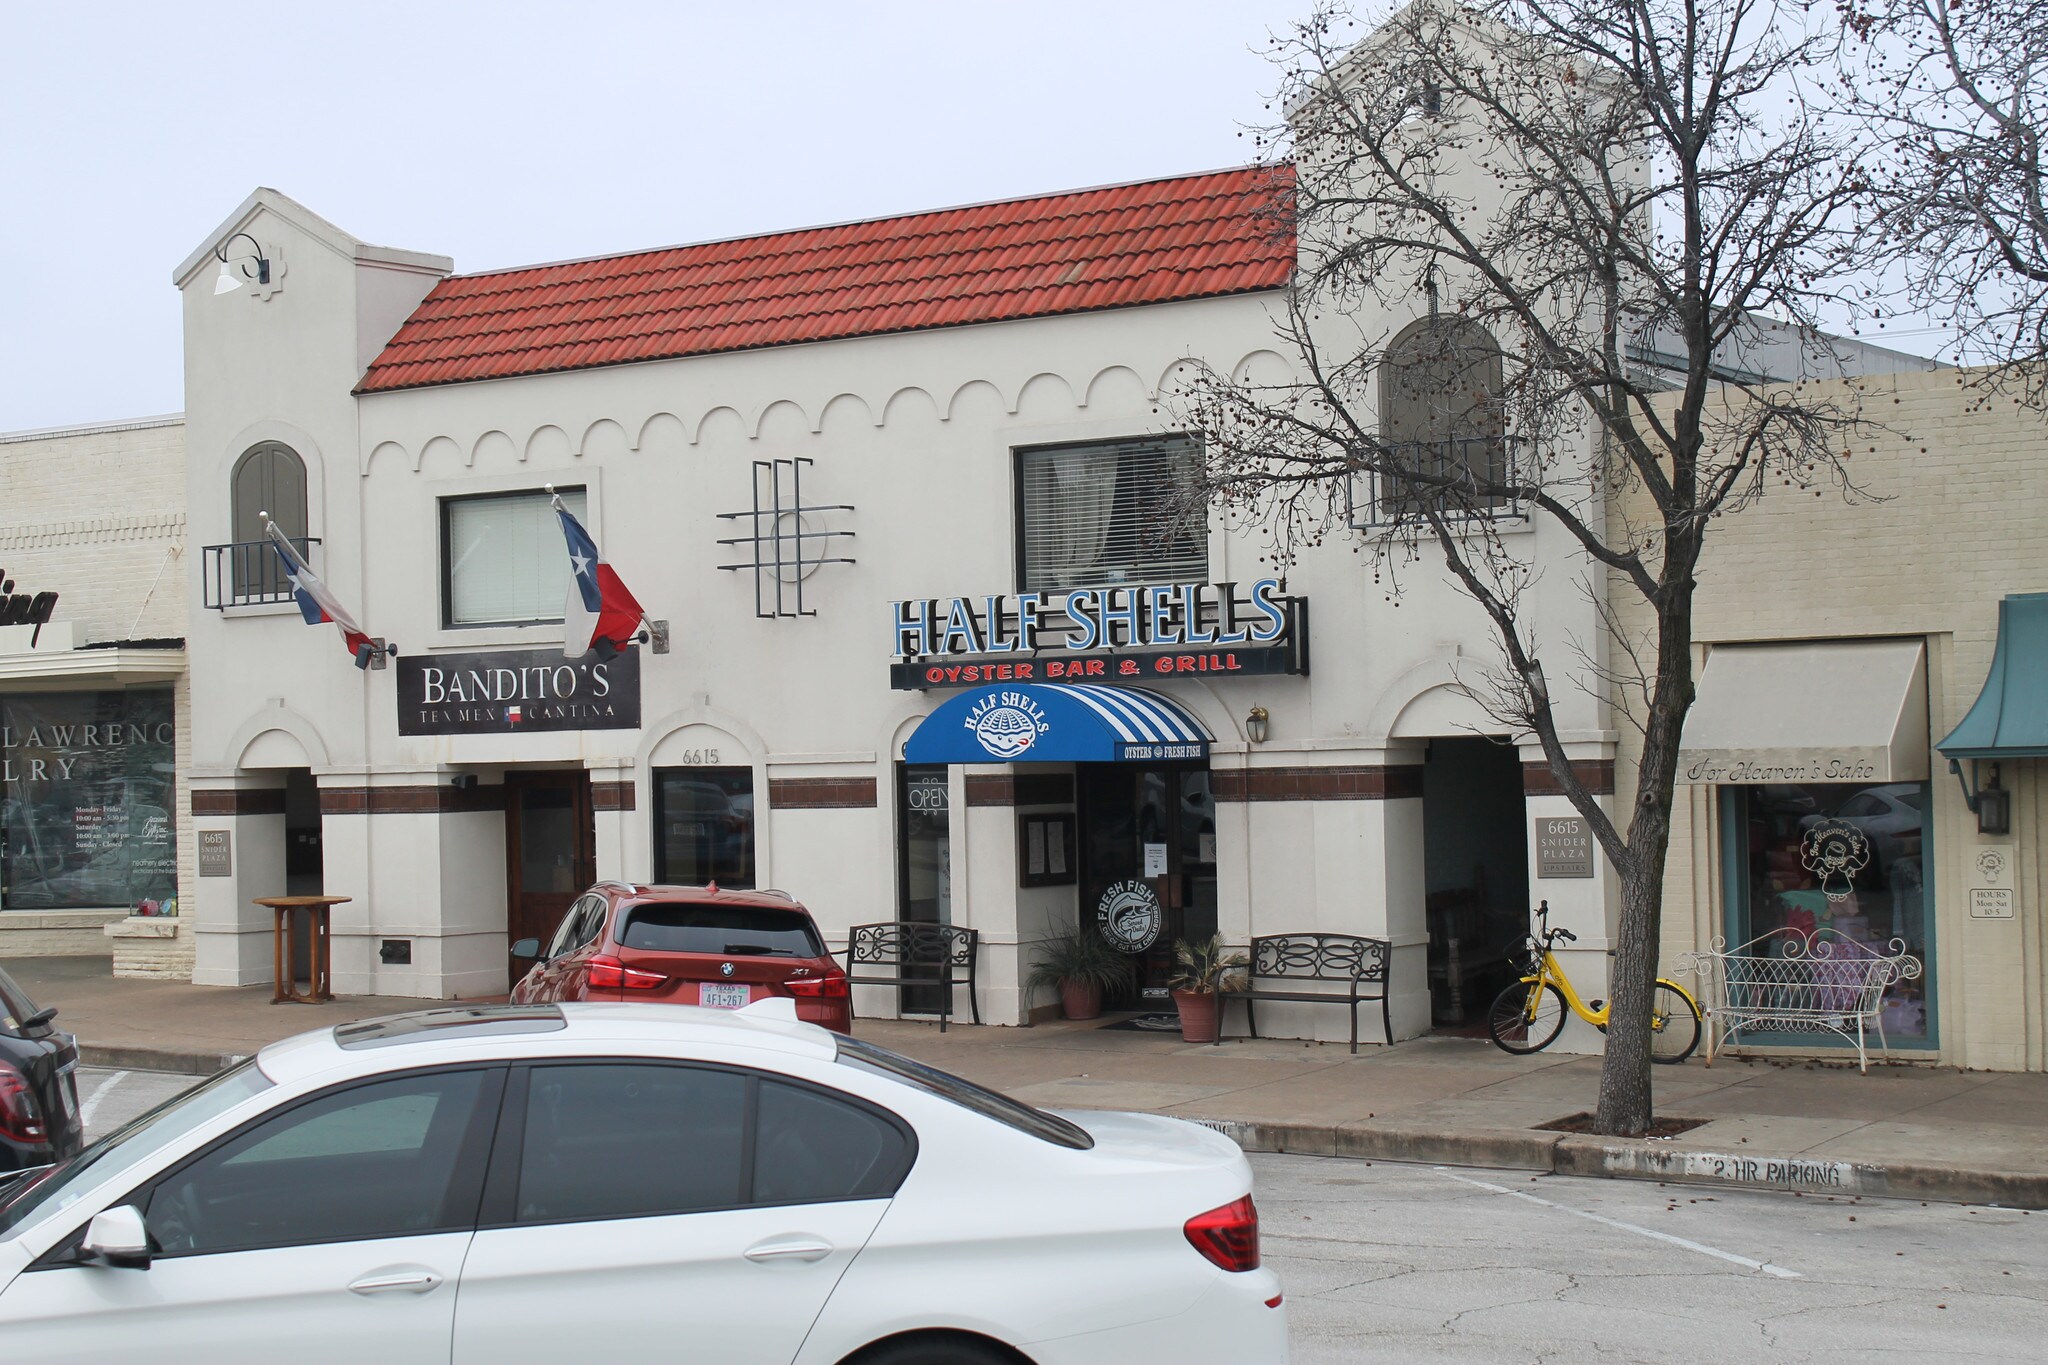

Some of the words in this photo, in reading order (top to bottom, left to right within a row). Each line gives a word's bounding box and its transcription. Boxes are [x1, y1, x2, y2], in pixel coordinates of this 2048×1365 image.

[890, 592, 1046, 658] HALF
[1065, 578, 1288, 650] SHELLS
[925, 663, 1033, 683] OYSTER
[1046, 659, 1104, 678] BAR
[1119, 659, 1140, 675] &
[1154, 653, 1242, 673] GRILL
[421, 663, 610, 704] BANDITO'S
[458, 708, 495, 722] MEX
[529, 704, 615, 719] CANTINA
[964, 693, 996, 731] HALF
[1001, 691, 1049, 733] SHELLS
[682, 749, 719, 764] 6615
[1124, 746, 1152, 759] OYSTERS
[1164, 745, 1186, 758] FRESH
[1186, 745, 1201, 758] FISH
[3, 758, 77, 782] LRY
[1687, 757, 1726, 781] For
[1729, 760, 1820, 781] Heaven's
[1824, 759, 1875, 779] Sake
[909, 787, 949, 808] OPEN
[1548, 821, 1579, 834] 6615
[205, 833, 223, 844] 6615
[1541, 838, 1586, 847] SNIDER
[202, 854, 226, 862] PLAZA
[1543, 850, 1585, 858] PLAZA
[1098, 881, 1124, 920] FRESH
[1127, 880, 1154, 902] FISH
[1131, 943, 1142, 951] THE
[1735, 1161, 1758, 1182] HR
[1766, 1162, 1839, 1187] PARKING
